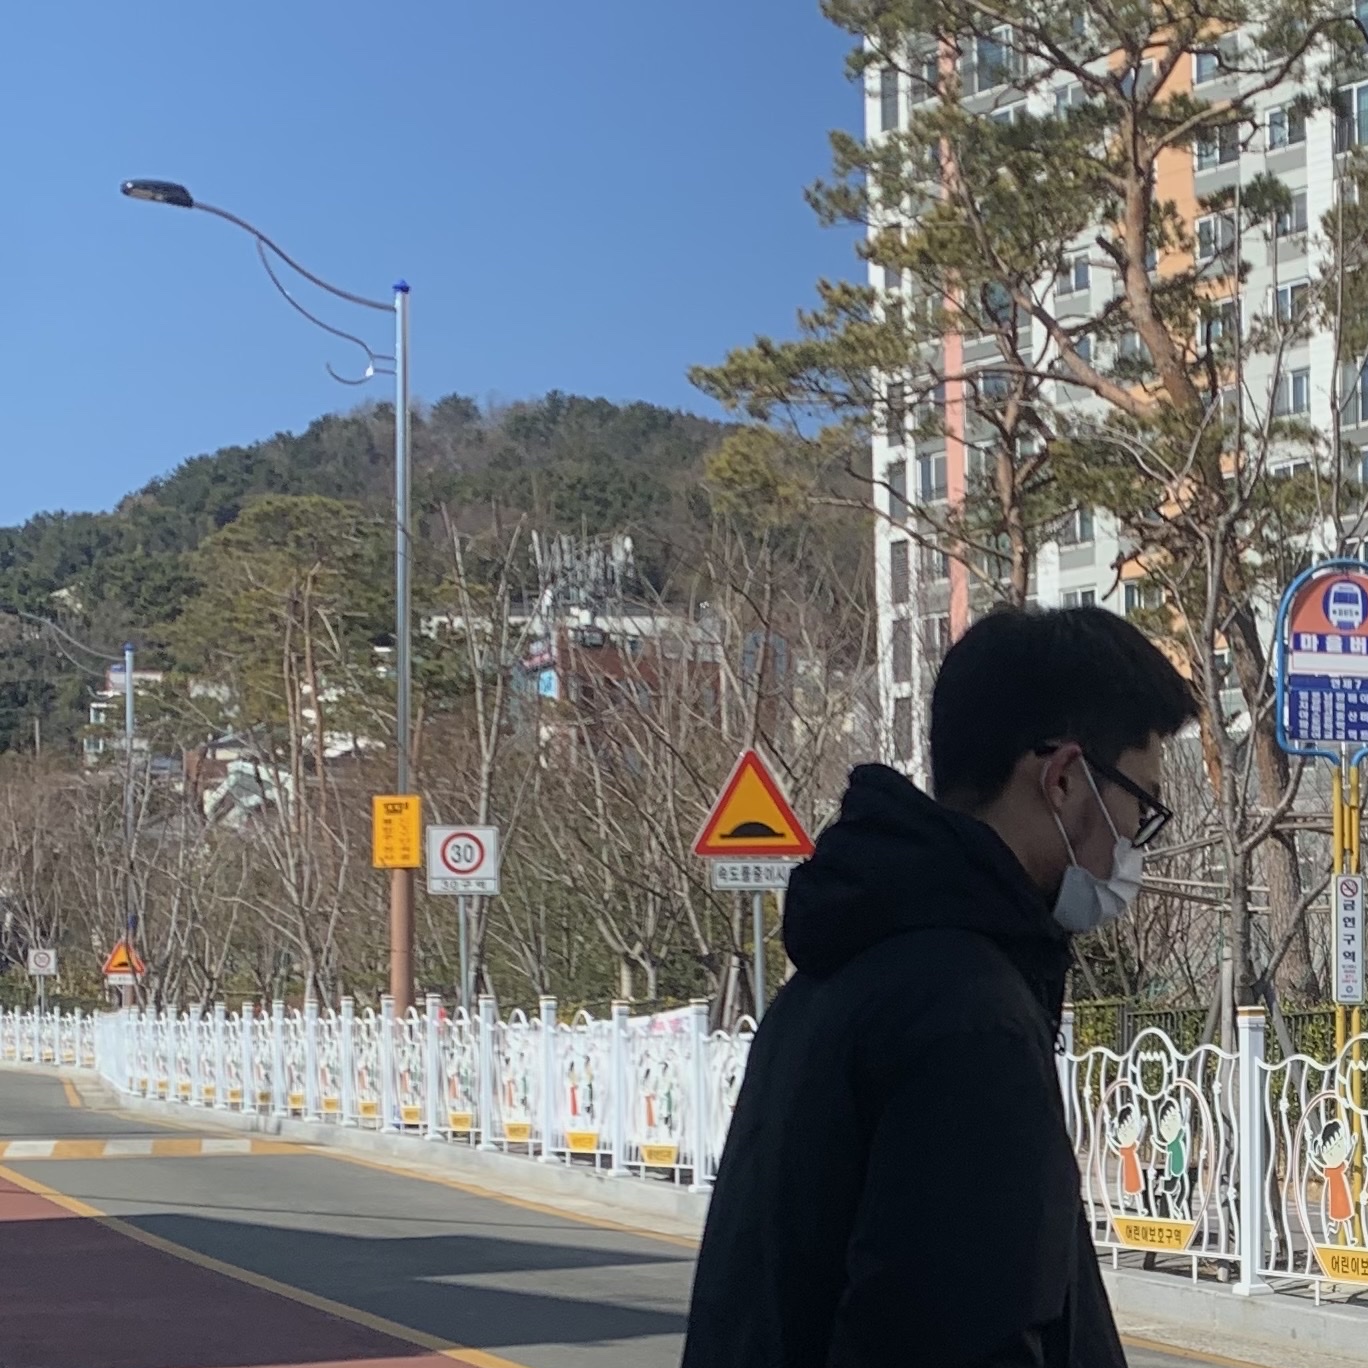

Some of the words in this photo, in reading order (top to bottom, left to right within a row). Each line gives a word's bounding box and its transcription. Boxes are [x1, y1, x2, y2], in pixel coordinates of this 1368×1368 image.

[450, 844, 474, 863] 30
[718, 865, 788, 882] 속도를줄이시
[1342, 899, 1356, 962] 금연구역
